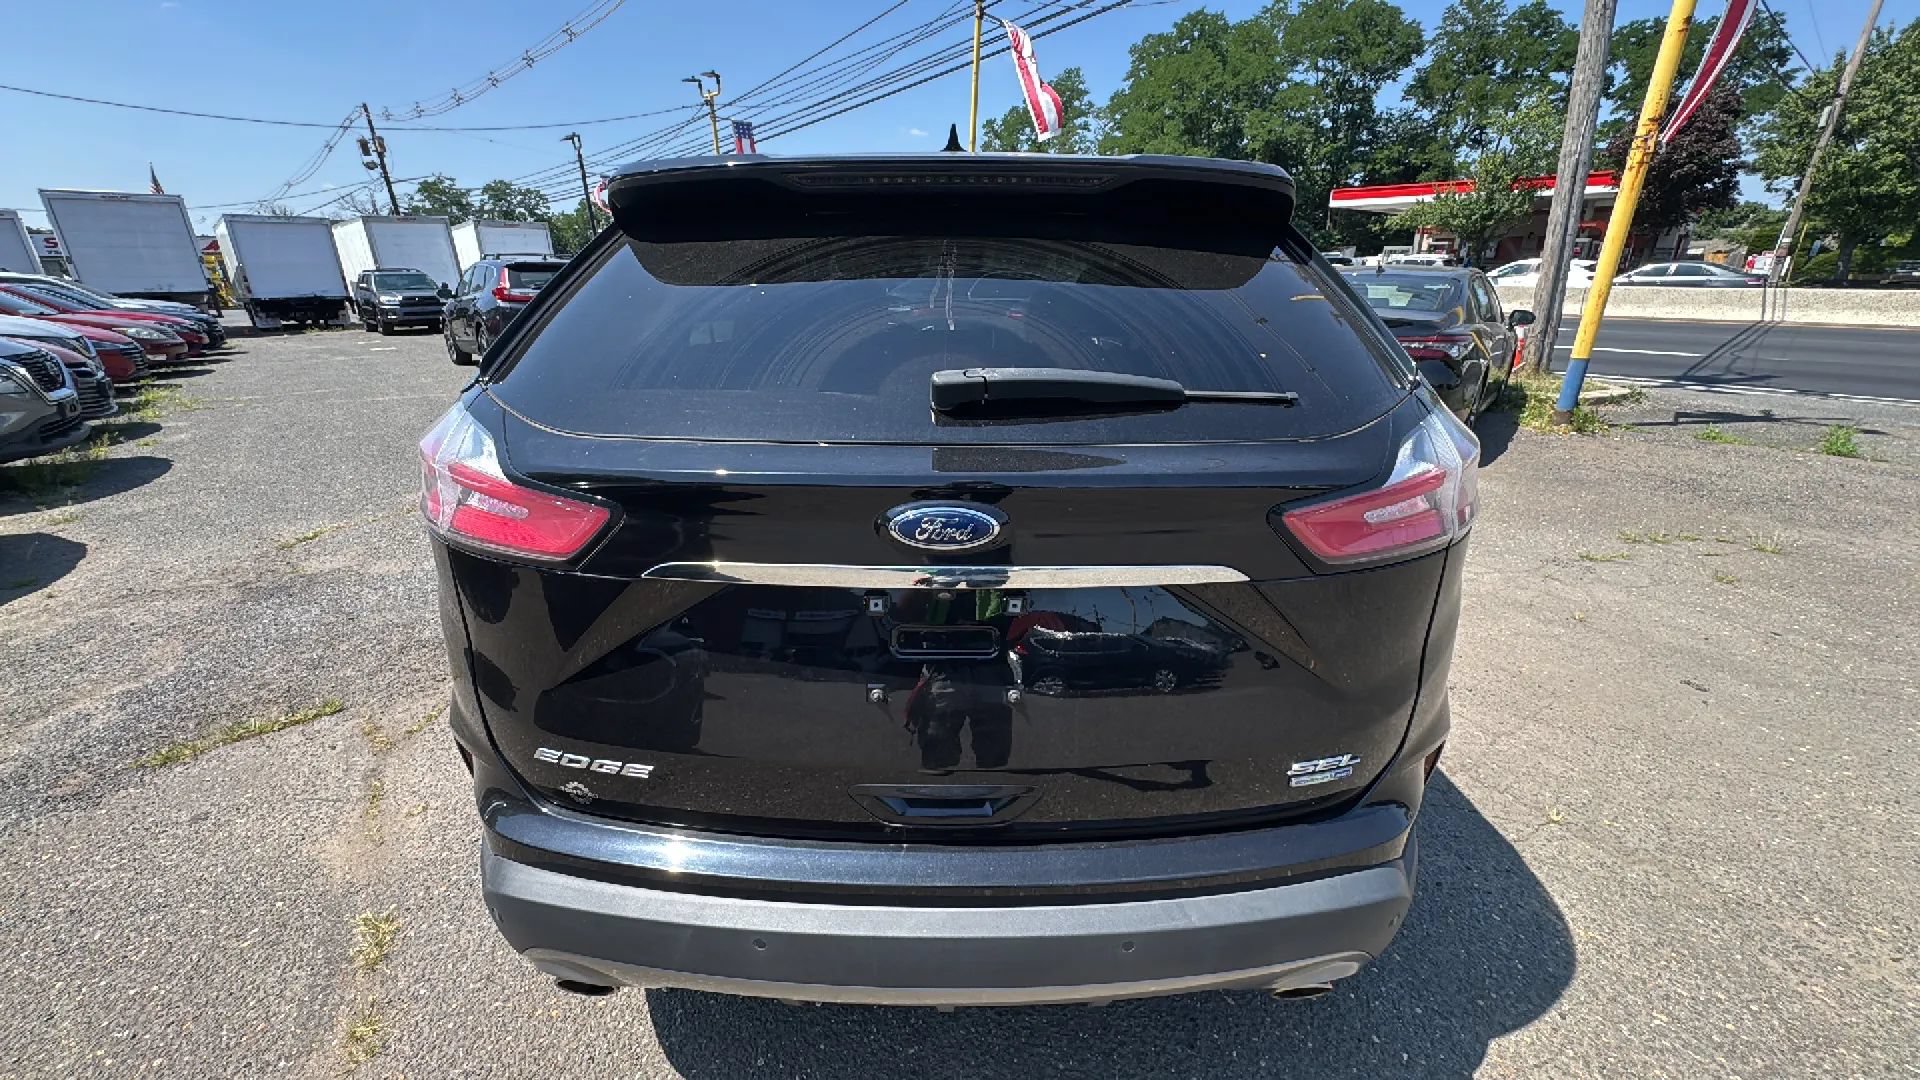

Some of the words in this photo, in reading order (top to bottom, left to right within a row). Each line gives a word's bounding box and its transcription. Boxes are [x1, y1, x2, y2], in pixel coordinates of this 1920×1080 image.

[915, 517, 975, 541] Ford
[534, 747, 655, 779] EDGE
[1286, 753, 1361, 776] SEL
